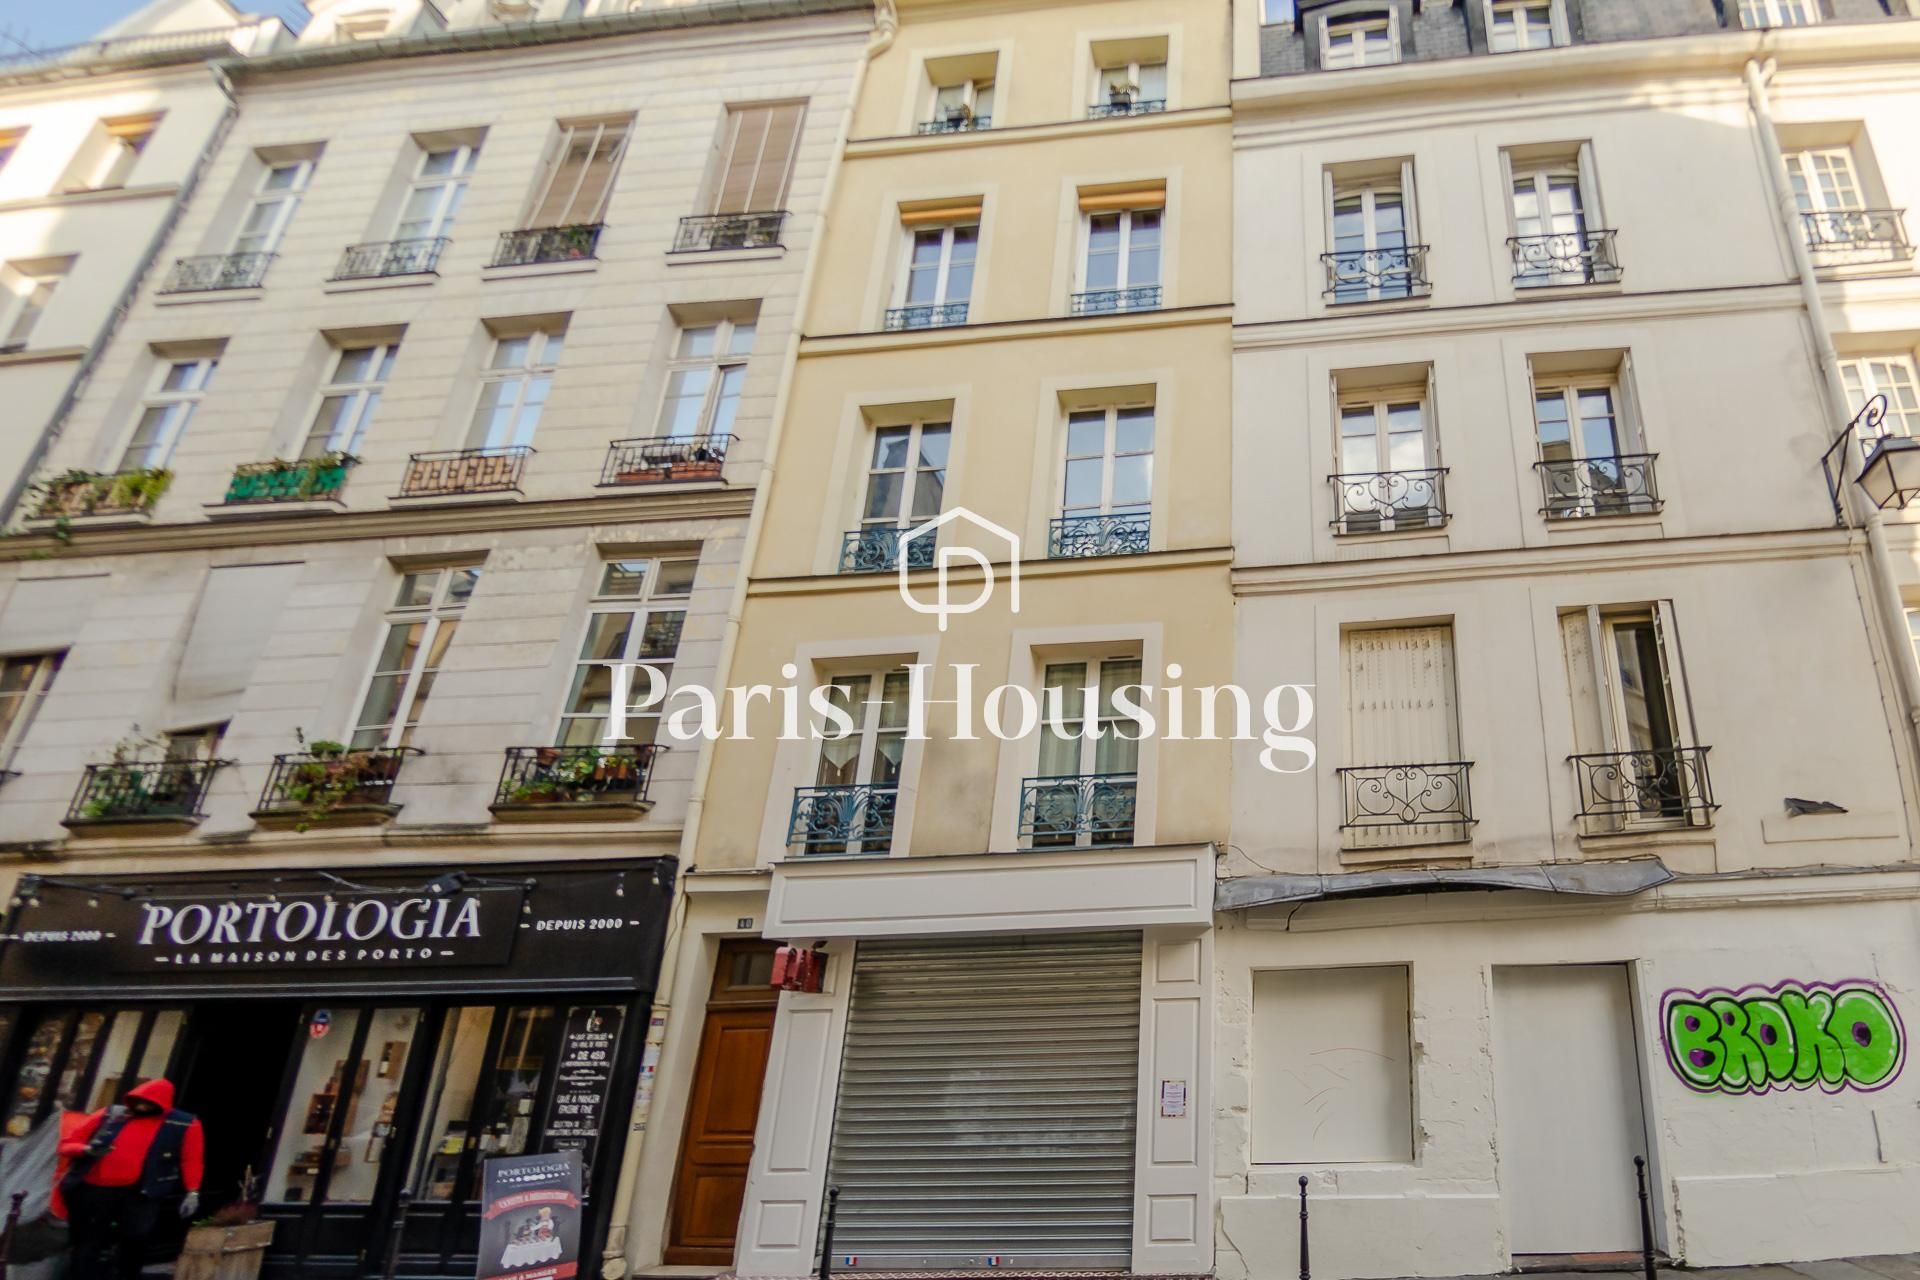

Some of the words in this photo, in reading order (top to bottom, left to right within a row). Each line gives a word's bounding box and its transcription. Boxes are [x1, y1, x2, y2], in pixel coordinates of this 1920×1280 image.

[139, 898, 481, 945] PORTOLOGIA
[536, 919, 586, 931] DEPUIS
[589, 918, 623, 930] 2000
[23, 930, 68, 942] DEPUIS
[71, 930, 101, 942] 2000
[175, 952, 200, 965] LA
[210, 950, 297, 964] MAISON
[306, 949, 348, 963] DES
[357, 946, 432, 961] PORTO
[1667, 987, 1901, 1089] BROKO
[498, 1162, 570, 1177] PORTOLOGIA
